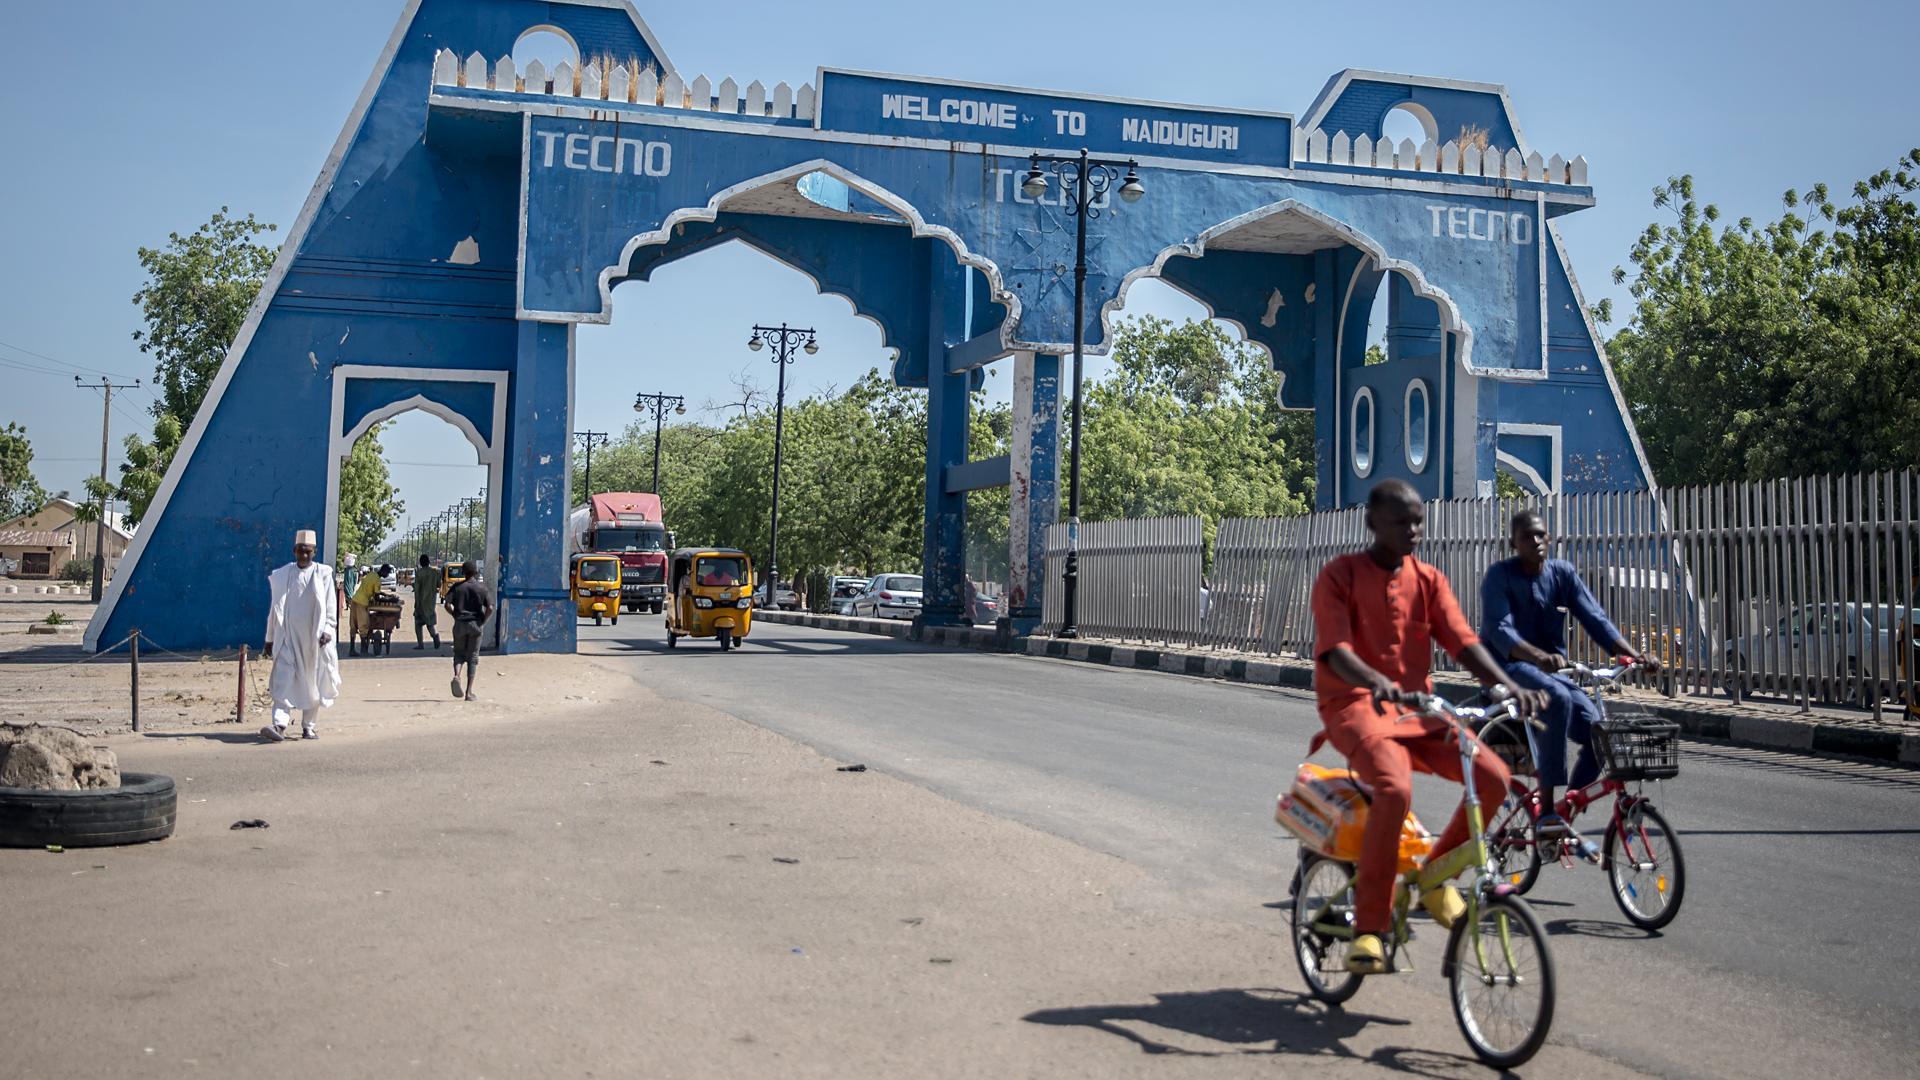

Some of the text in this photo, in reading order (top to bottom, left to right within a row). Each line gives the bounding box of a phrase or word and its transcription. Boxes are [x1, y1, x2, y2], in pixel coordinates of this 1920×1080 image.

[882, 93, 1239, 150] WELCOME TO MAIDUGURI
[536, 130, 672, 177] TECNO
[1425, 204, 1533, 245] TECNO
